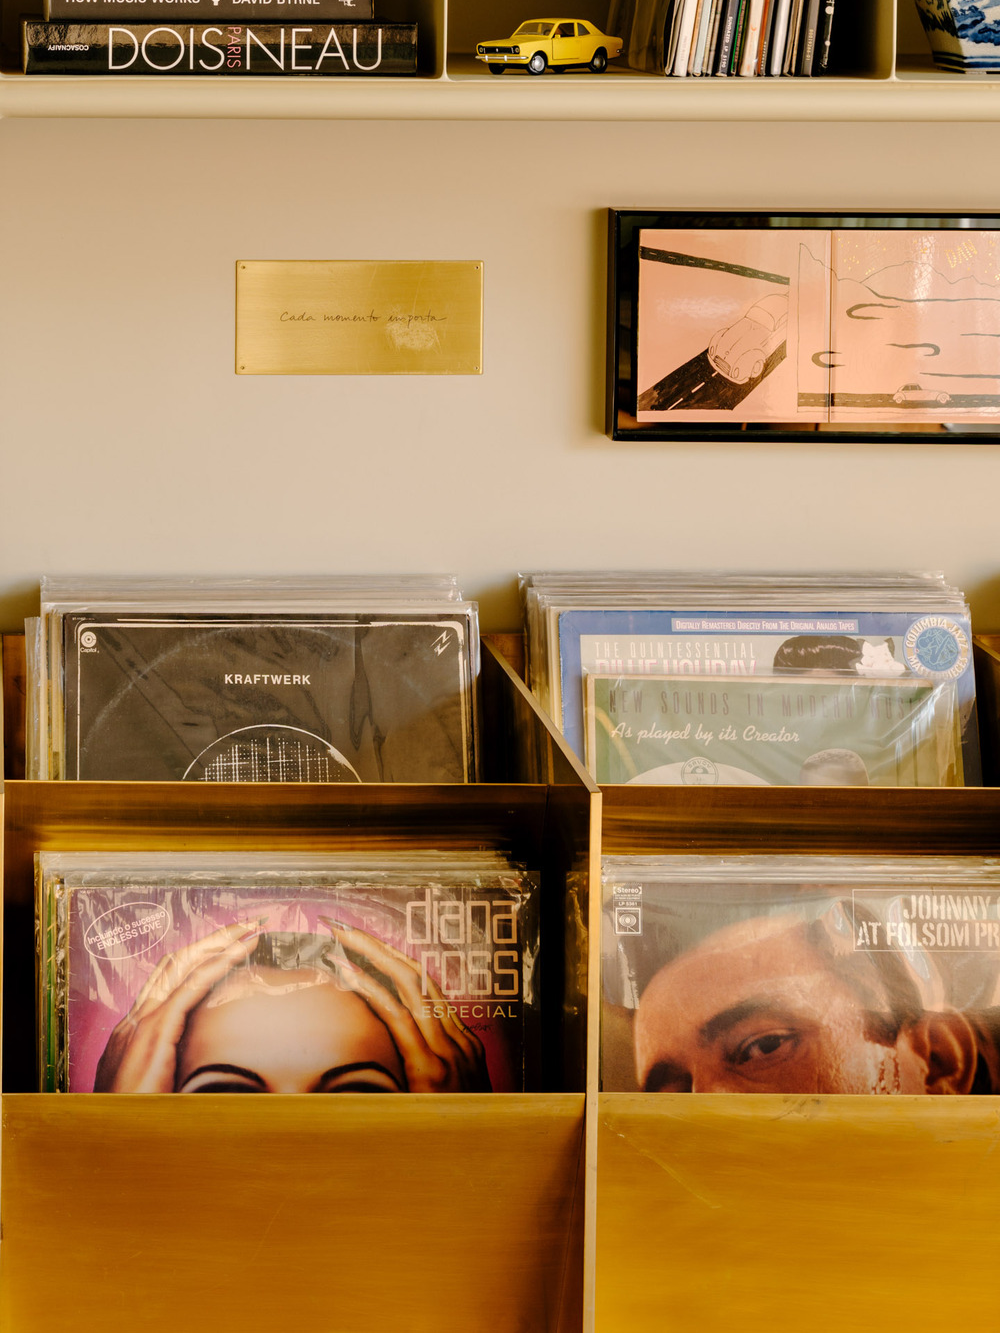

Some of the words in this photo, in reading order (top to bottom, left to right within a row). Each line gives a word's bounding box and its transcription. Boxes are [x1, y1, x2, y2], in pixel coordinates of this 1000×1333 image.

[724, 16, 733, 42] SUNDAZED
[227, 26, 241, 68] PARIS
[280, 312, 316, 322] Cada
[324, 310, 381, 322] momento
[388, 309, 447, 327] importa
[906, 617, 947, 647] COLUMBIA
[595, 642, 619, 658] THE
[630, 642, 756, 659] QUINTESSENTIAL
[225, 674, 311, 685] KRAFTWERK
[609, 690, 643, 713] NEW
[661, 691, 729, 715] SOUNDS
[747, 693, 764, 716] IN
[781, 694, 853, 717] MODERN
[611, 722, 633, 739] As
[637, 724, 689, 744] played
[695, 724, 713, 745] by
[718, 727, 737, 740] its
[742, 725, 800, 743] Creator
[406, 888, 518, 944] diana
[903, 894, 989, 920] JOHNNY
[87, 927, 123, 944] Incluindo
[131, 911, 166, 928] sucesso
[97, 929, 139, 950] ENDLESS
[139, 920, 162, 935] LOVE
[857, 921, 881, 946] AT
[886, 921, 970, 947] FOLSOM
[421, 950, 519, 995] ross
[422, 1005, 518, 1019] ESPECIAL
